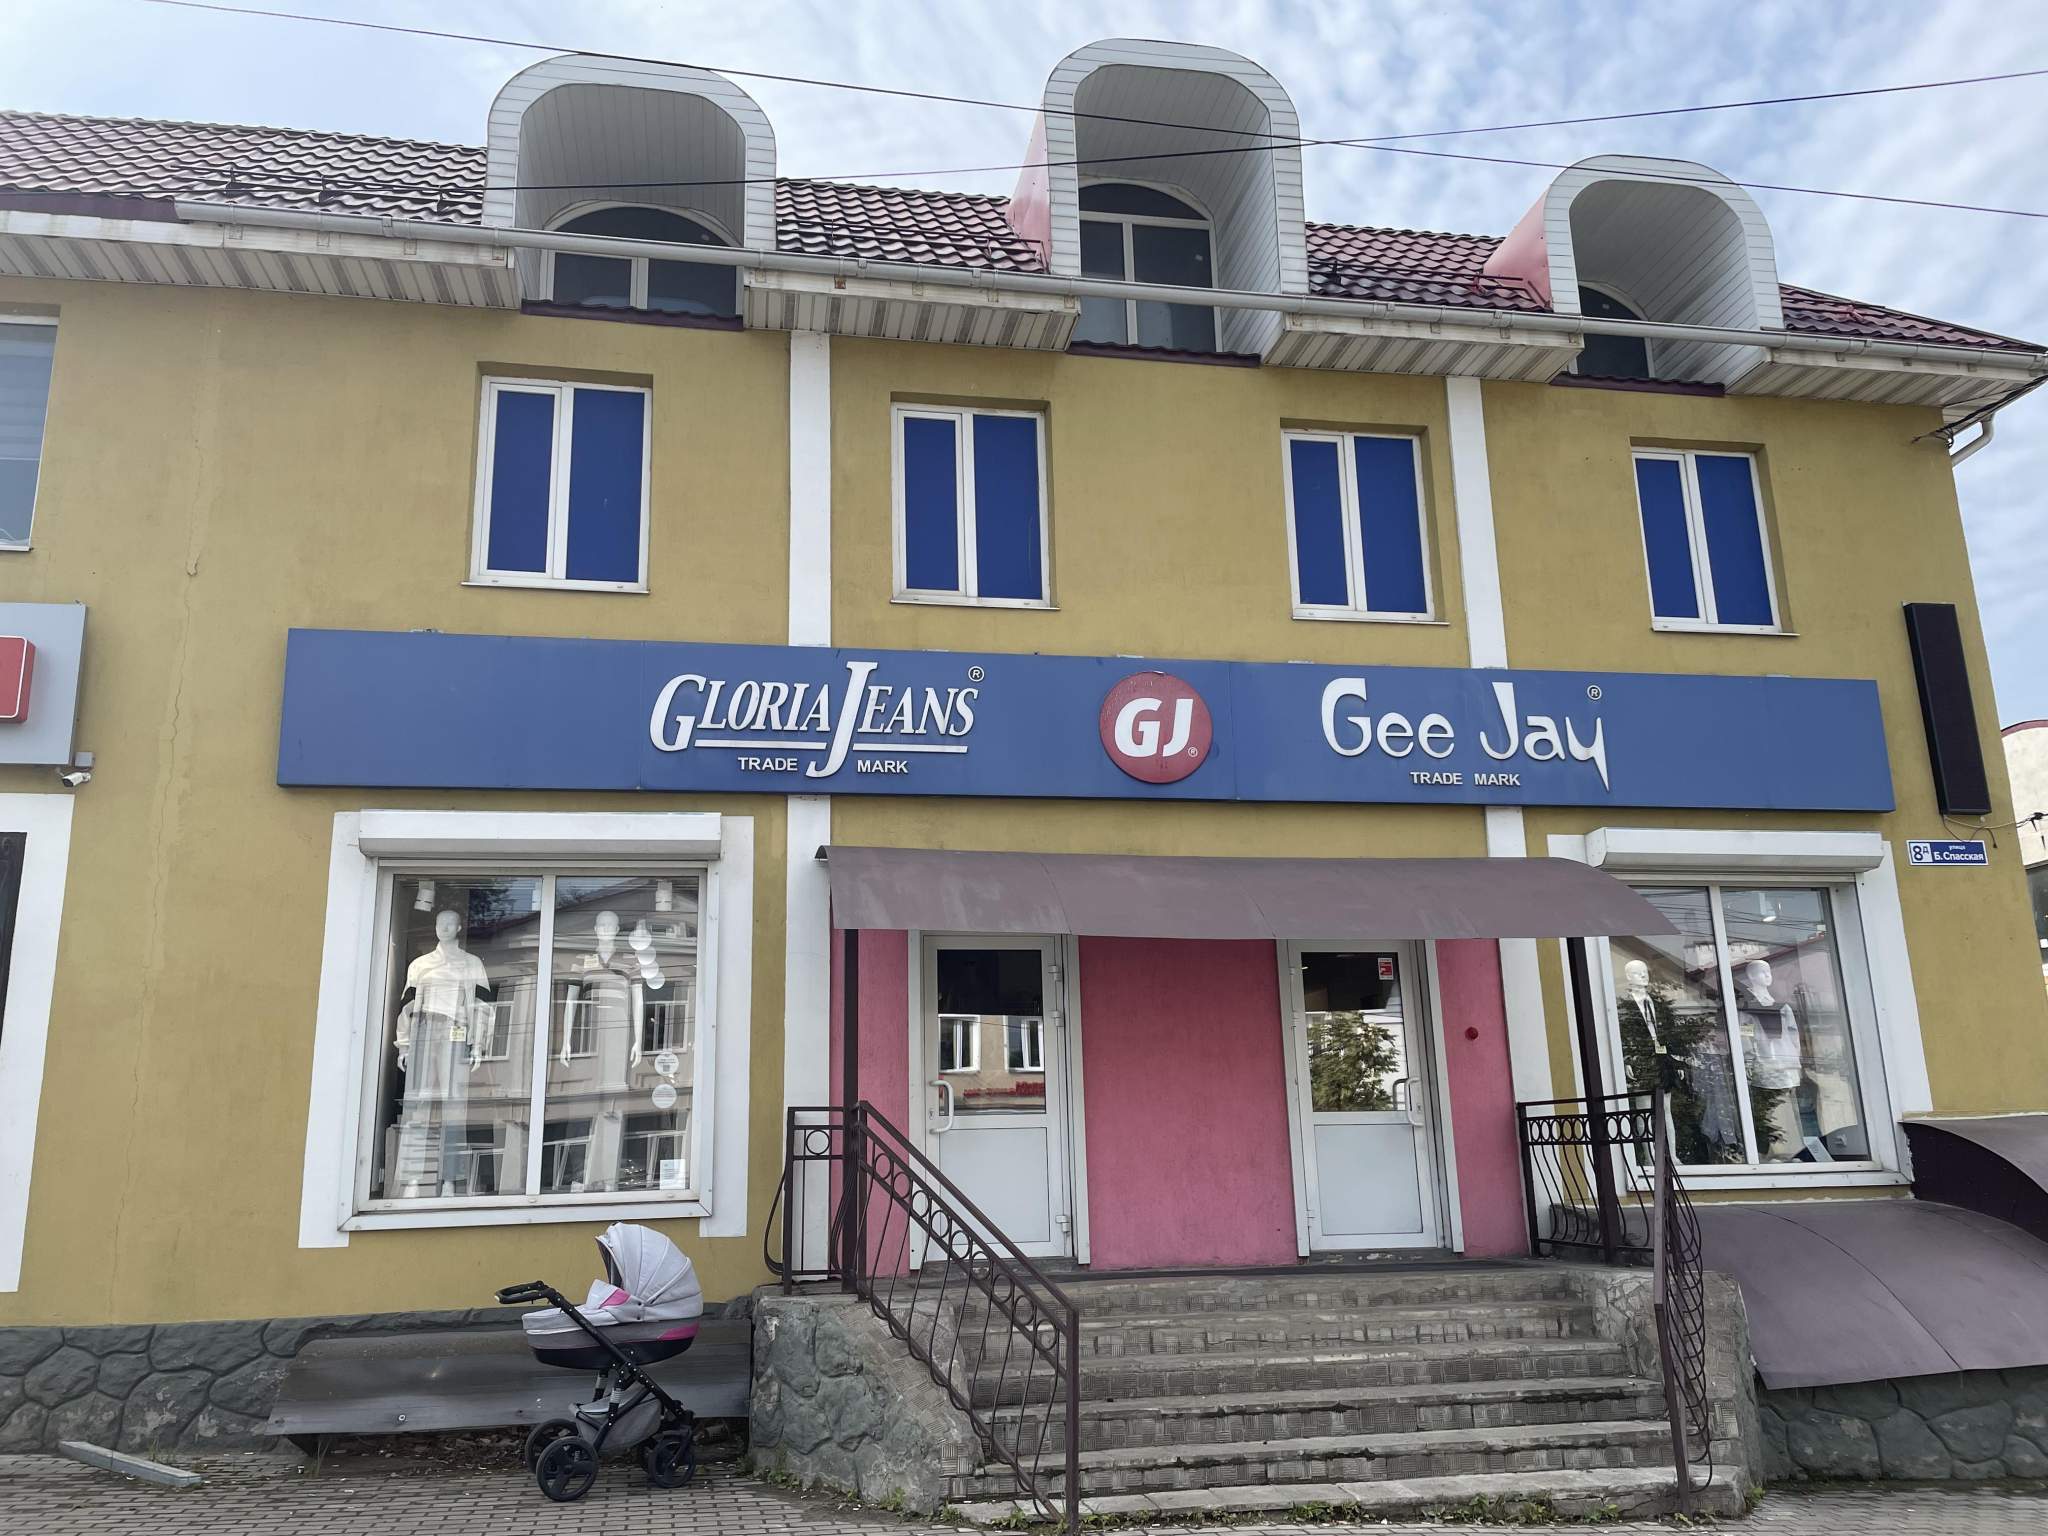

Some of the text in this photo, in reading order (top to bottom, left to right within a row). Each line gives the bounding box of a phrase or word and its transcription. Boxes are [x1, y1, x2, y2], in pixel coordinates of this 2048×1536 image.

[1114, 697, 1194, 758] GJ
[1321, 677, 1610, 792] Gee Jay
[737, 757, 909, 774] TRADE MARK
[1410, 771, 1521, 787] TRADE MARK
